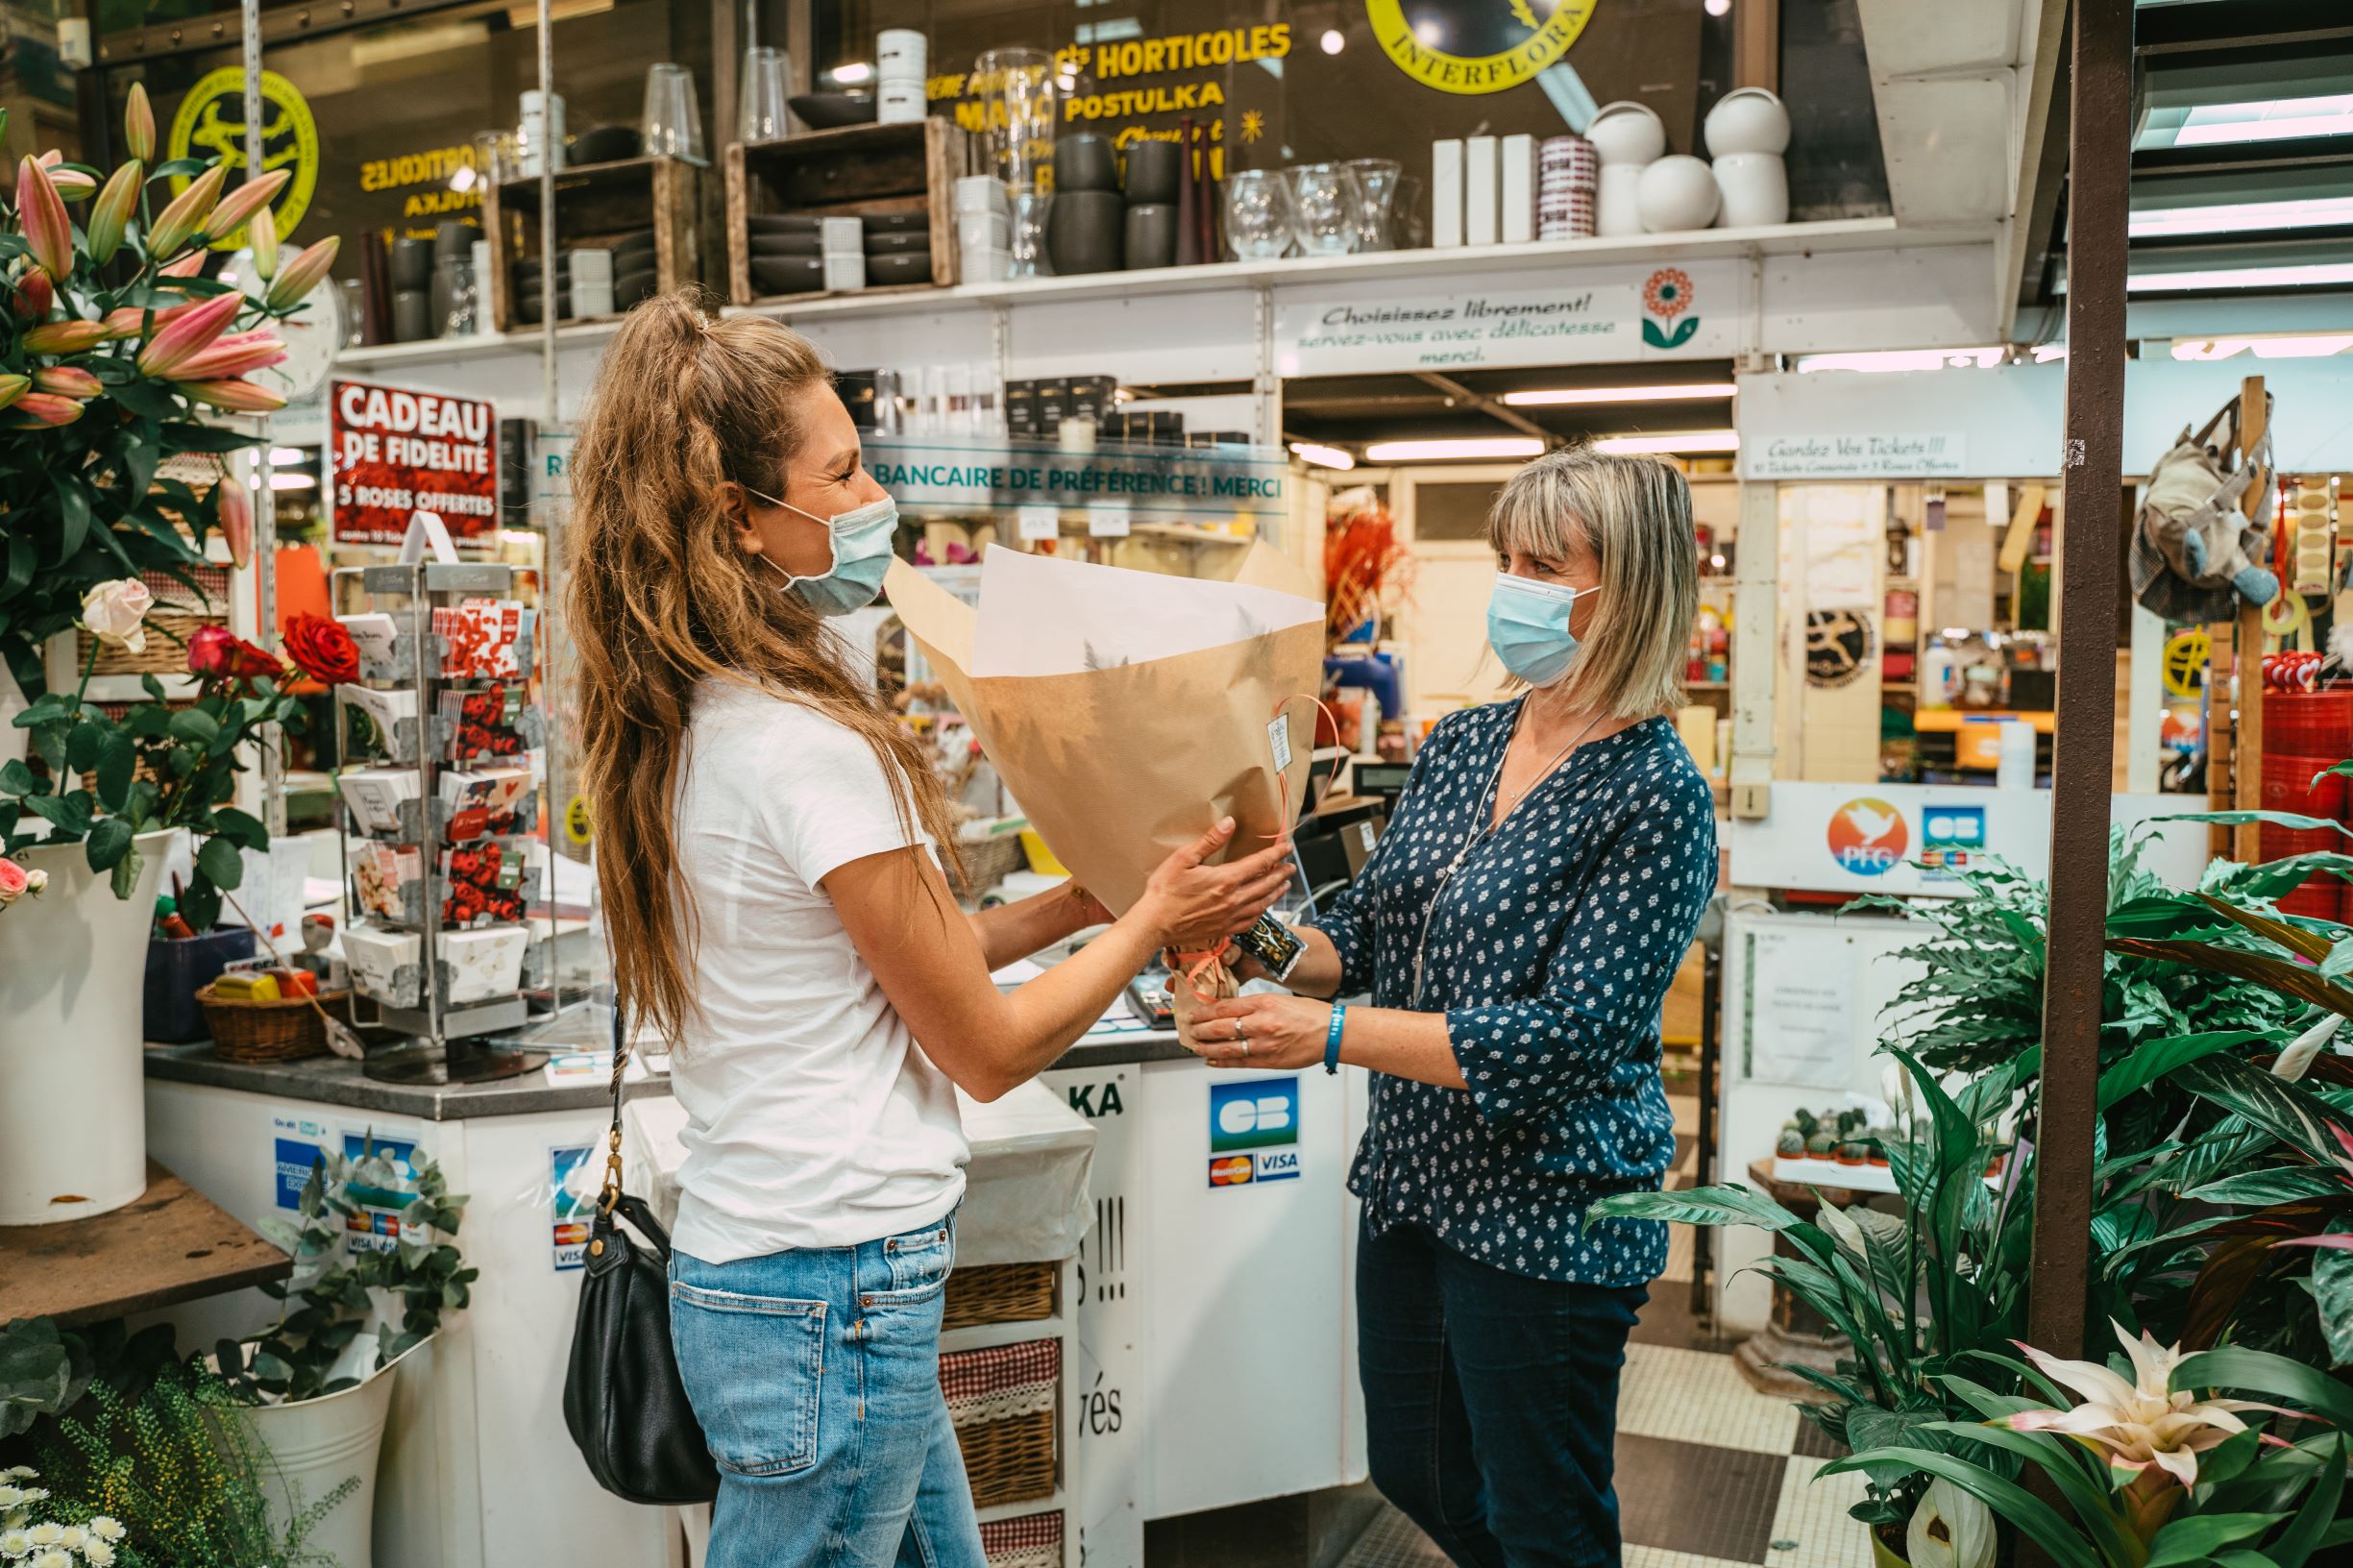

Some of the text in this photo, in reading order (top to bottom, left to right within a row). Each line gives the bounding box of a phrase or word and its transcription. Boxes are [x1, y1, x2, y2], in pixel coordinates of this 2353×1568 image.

[1096, 23, 1291, 79] HORTICOLES
[1391, 8, 1583, 86] INTERFLORA
[1064, 81, 1225, 122] POSTULKA
[1322, 293, 1592, 327] Choisissez librement!
[1297, 318, 1616, 350] servez-vous avec délicatesse
[340, 385, 488, 442] CADEAU
[343, 431, 489, 474] DE FIDELITÉ
[874, 464, 1003, 489] BANCAIRE
[1010, 468, 1042, 490] DE
[1048, 467, 1196, 496] PRÉFÉRENCE
[1213, 476, 1282, 499] MERCI
[355, 485, 413, 510] ROSES
[415, 491, 494, 517] OFFERTES
[1843, 845, 1895, 870] PFG
[1219, 1096, 1289, 1134] CB
[1262, 1153, 1298, 1170] VISA
